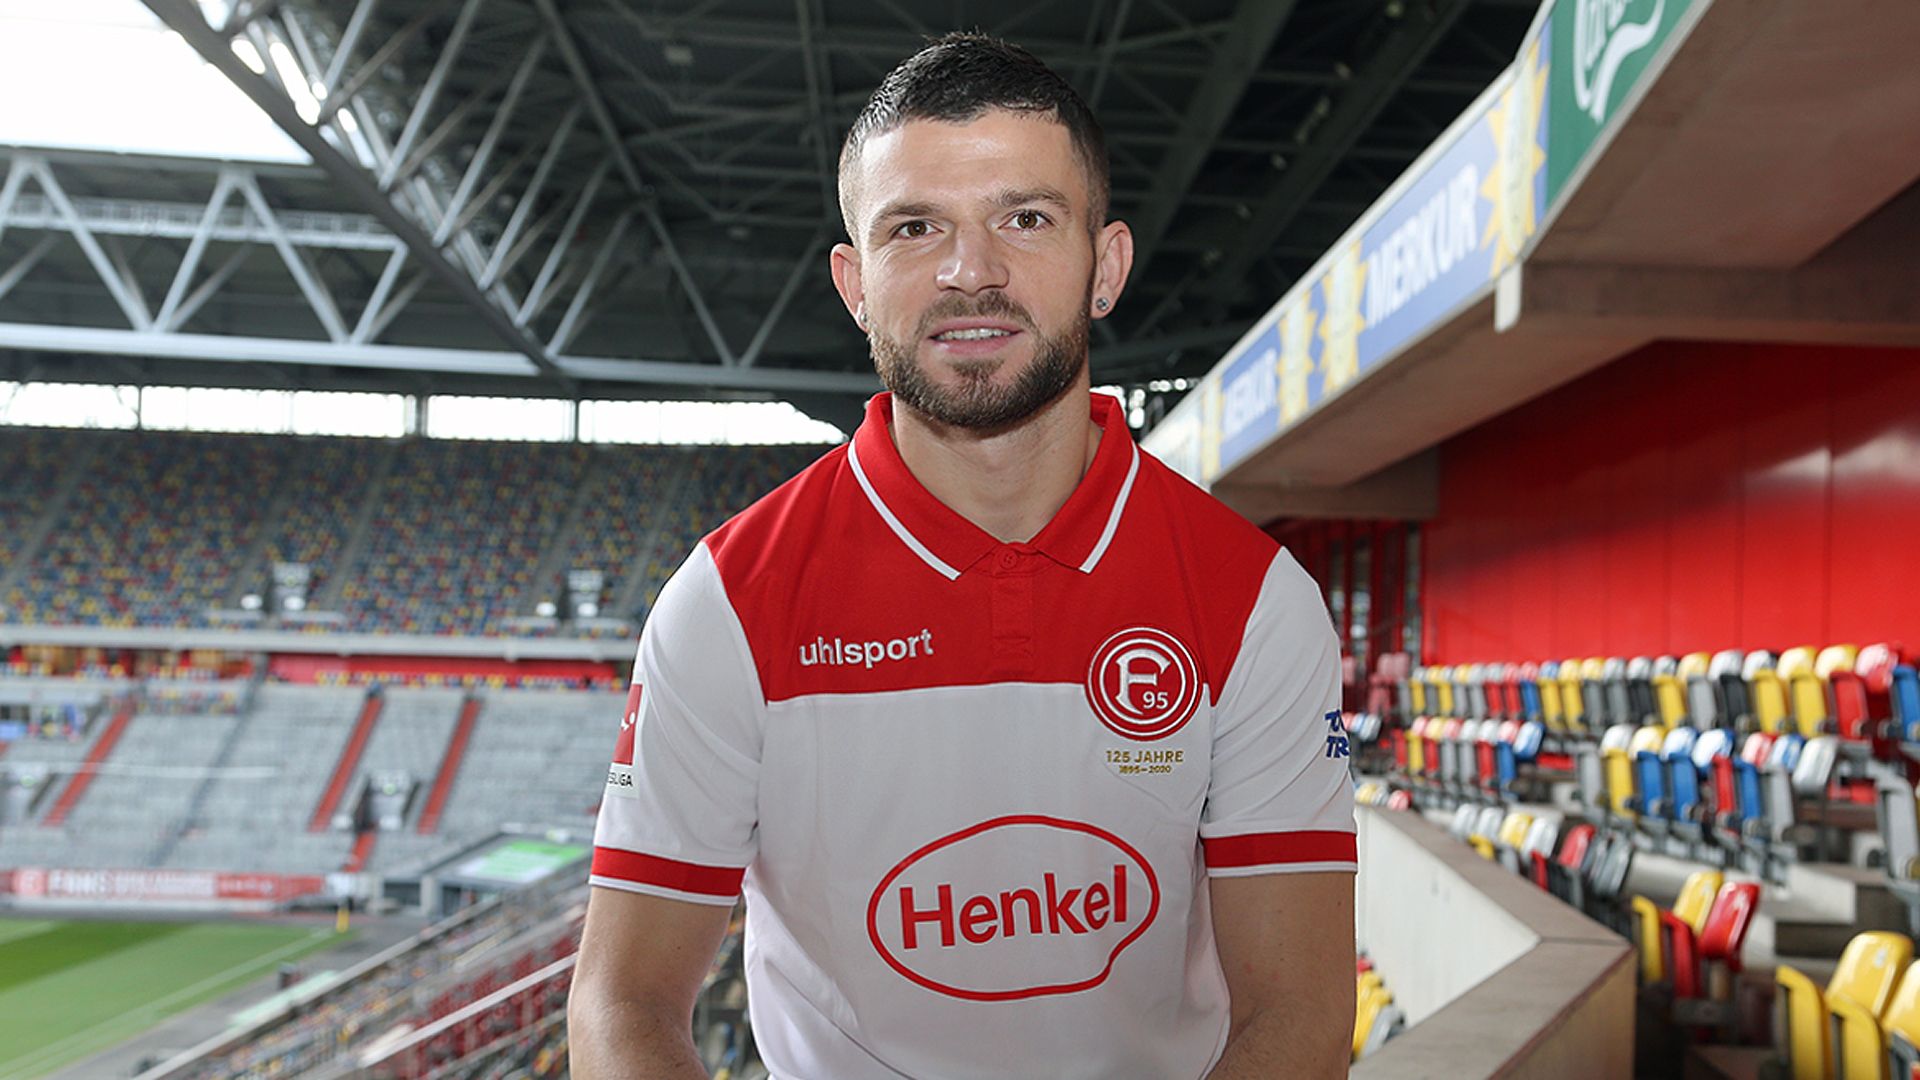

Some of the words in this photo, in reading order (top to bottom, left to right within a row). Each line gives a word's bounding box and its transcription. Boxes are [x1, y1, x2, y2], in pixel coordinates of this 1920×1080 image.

[1366, 163, 1477, 329] MERKUR
[800, 628, 934, 668] uhlsport
[1142, 691, 1168, 709] 95
[1106, 750, 1130, 763] 125
[1134, 750, 1184, 763] JAHRE
[900, 864, 1126, 950] Henkel
